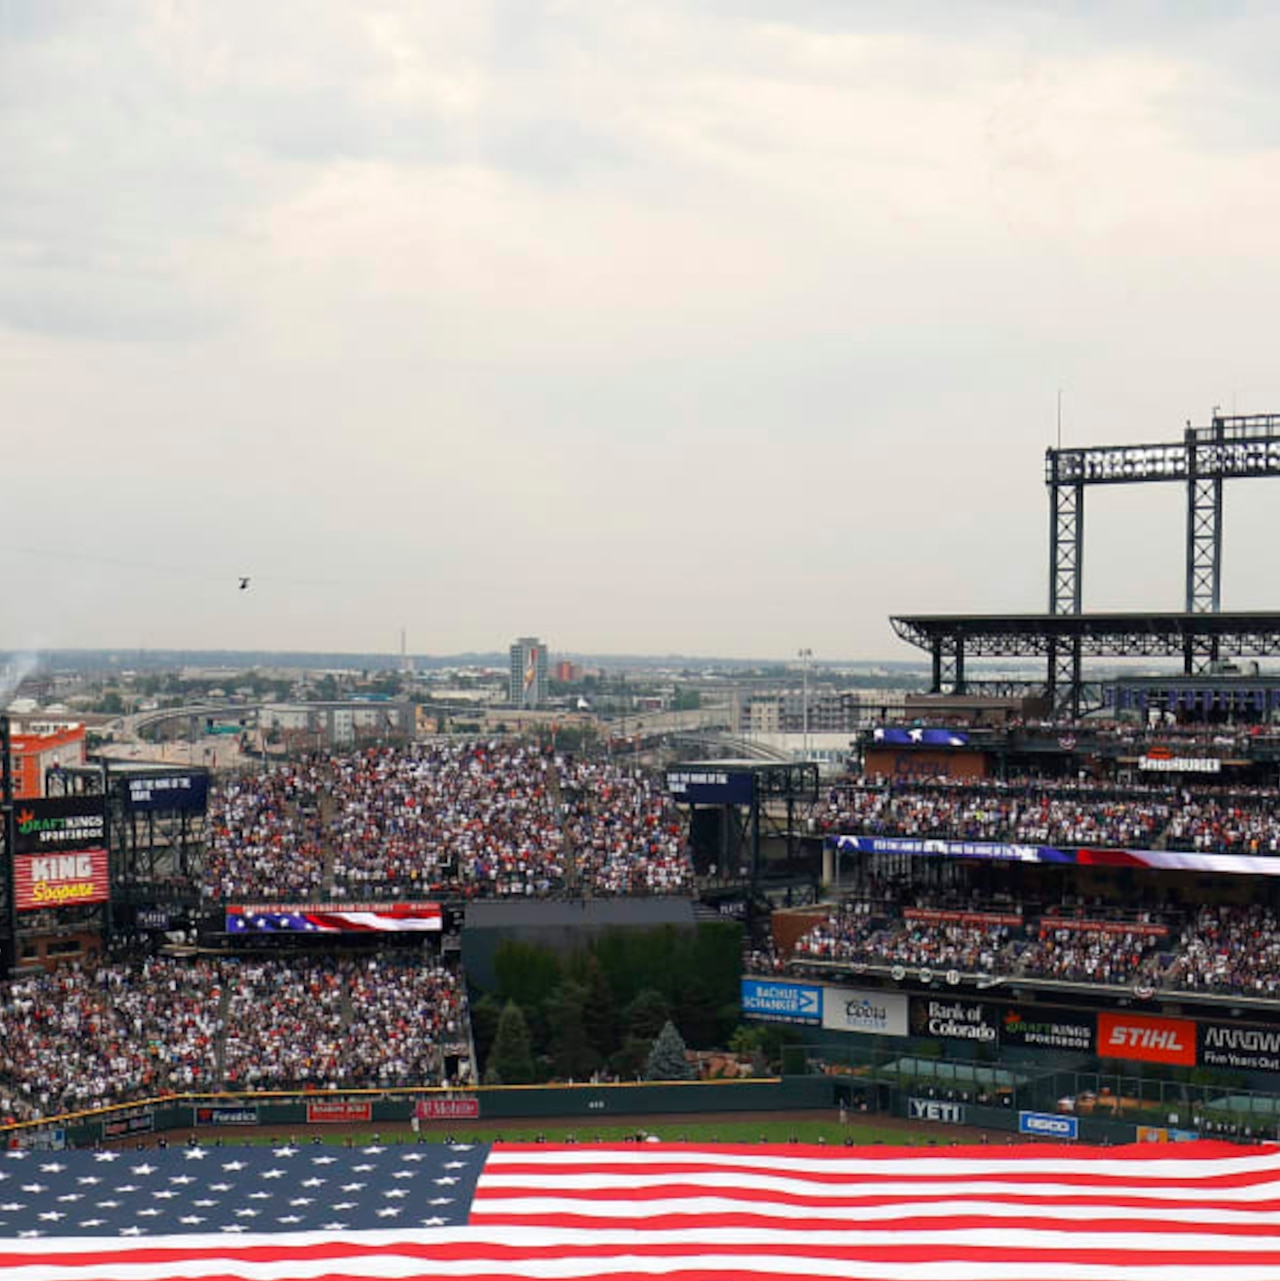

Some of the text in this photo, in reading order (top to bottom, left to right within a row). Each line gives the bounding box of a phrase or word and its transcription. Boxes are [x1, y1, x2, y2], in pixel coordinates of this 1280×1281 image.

[31, 855, 93, 881] KING
[33, 881, 94, 903] Soopers
[929, 1002, 982, 1022] Bank of
[928, 1019, 996, 1042] Colorado
[1108, 1027, 1184, 1052] STIHL
[1228, 1052, 1258, 1069] Years
[913, 1101, 960, 1123] YETI
